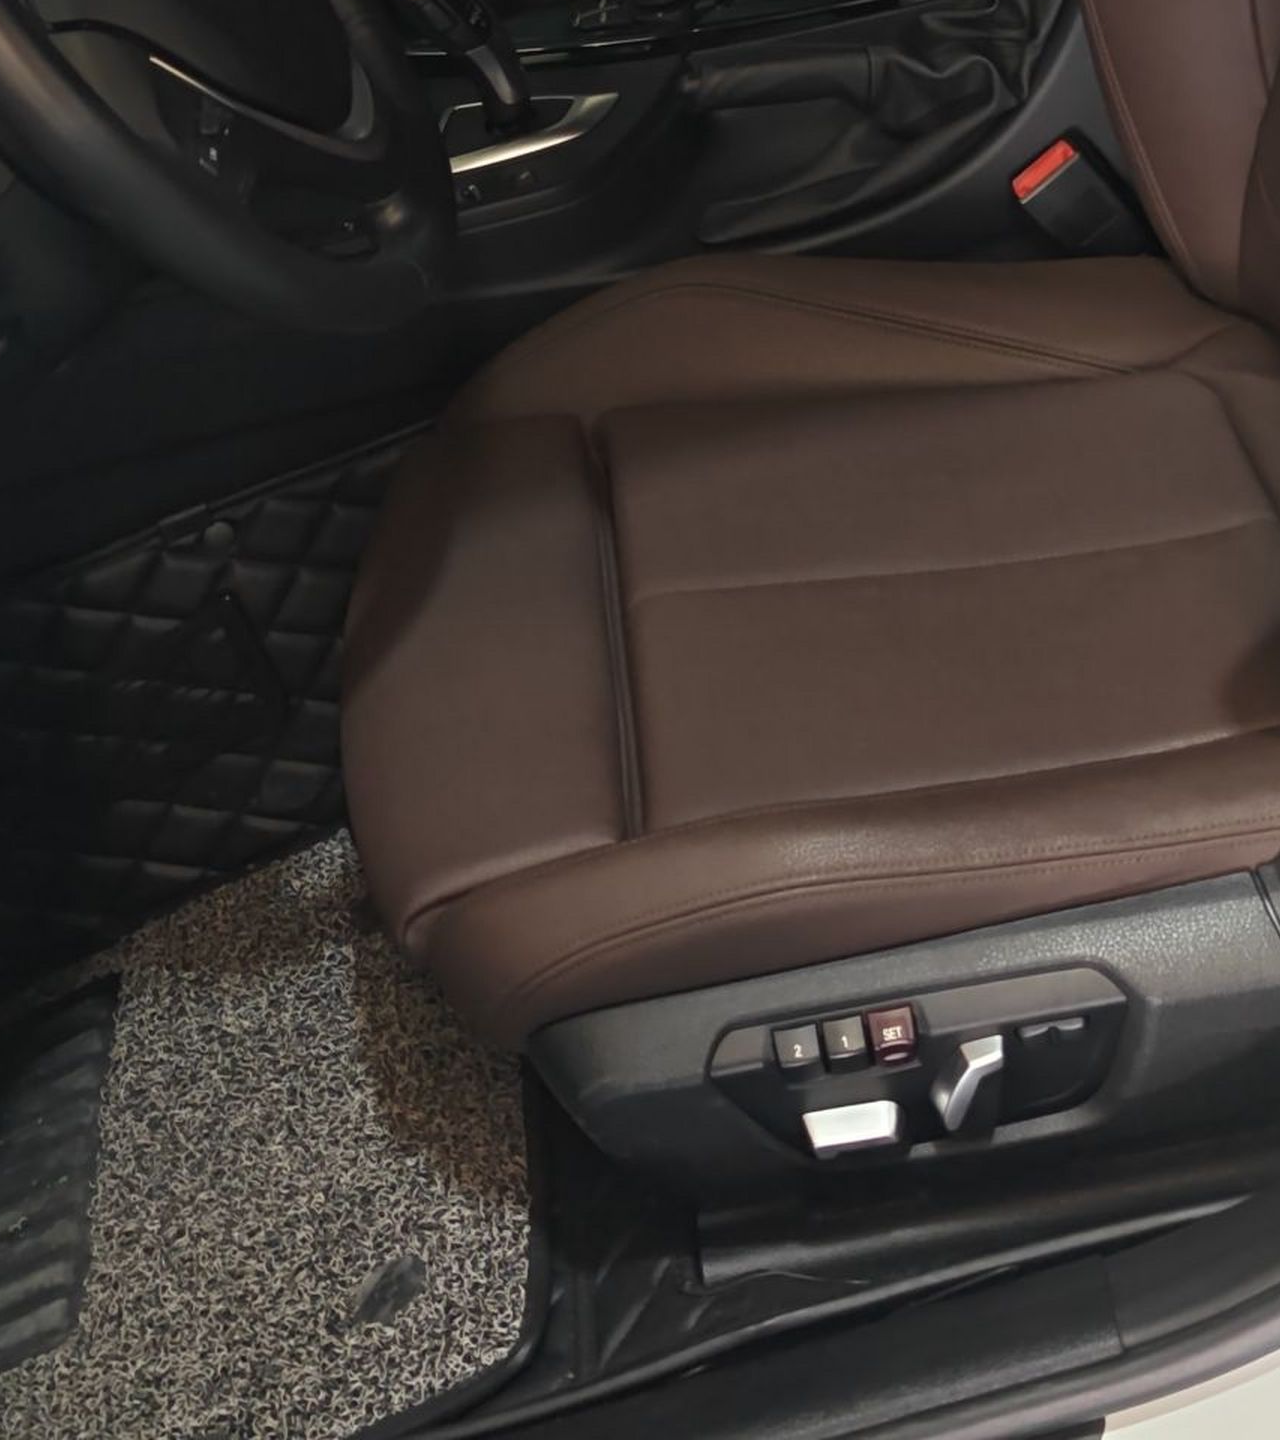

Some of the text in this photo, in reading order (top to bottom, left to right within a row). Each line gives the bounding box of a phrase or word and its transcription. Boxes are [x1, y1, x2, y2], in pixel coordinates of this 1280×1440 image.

[882, 1026, 903, 1041] SET
[841, 1036, 849, 1048] 1
[793, 1044, 803, 1058] 2
